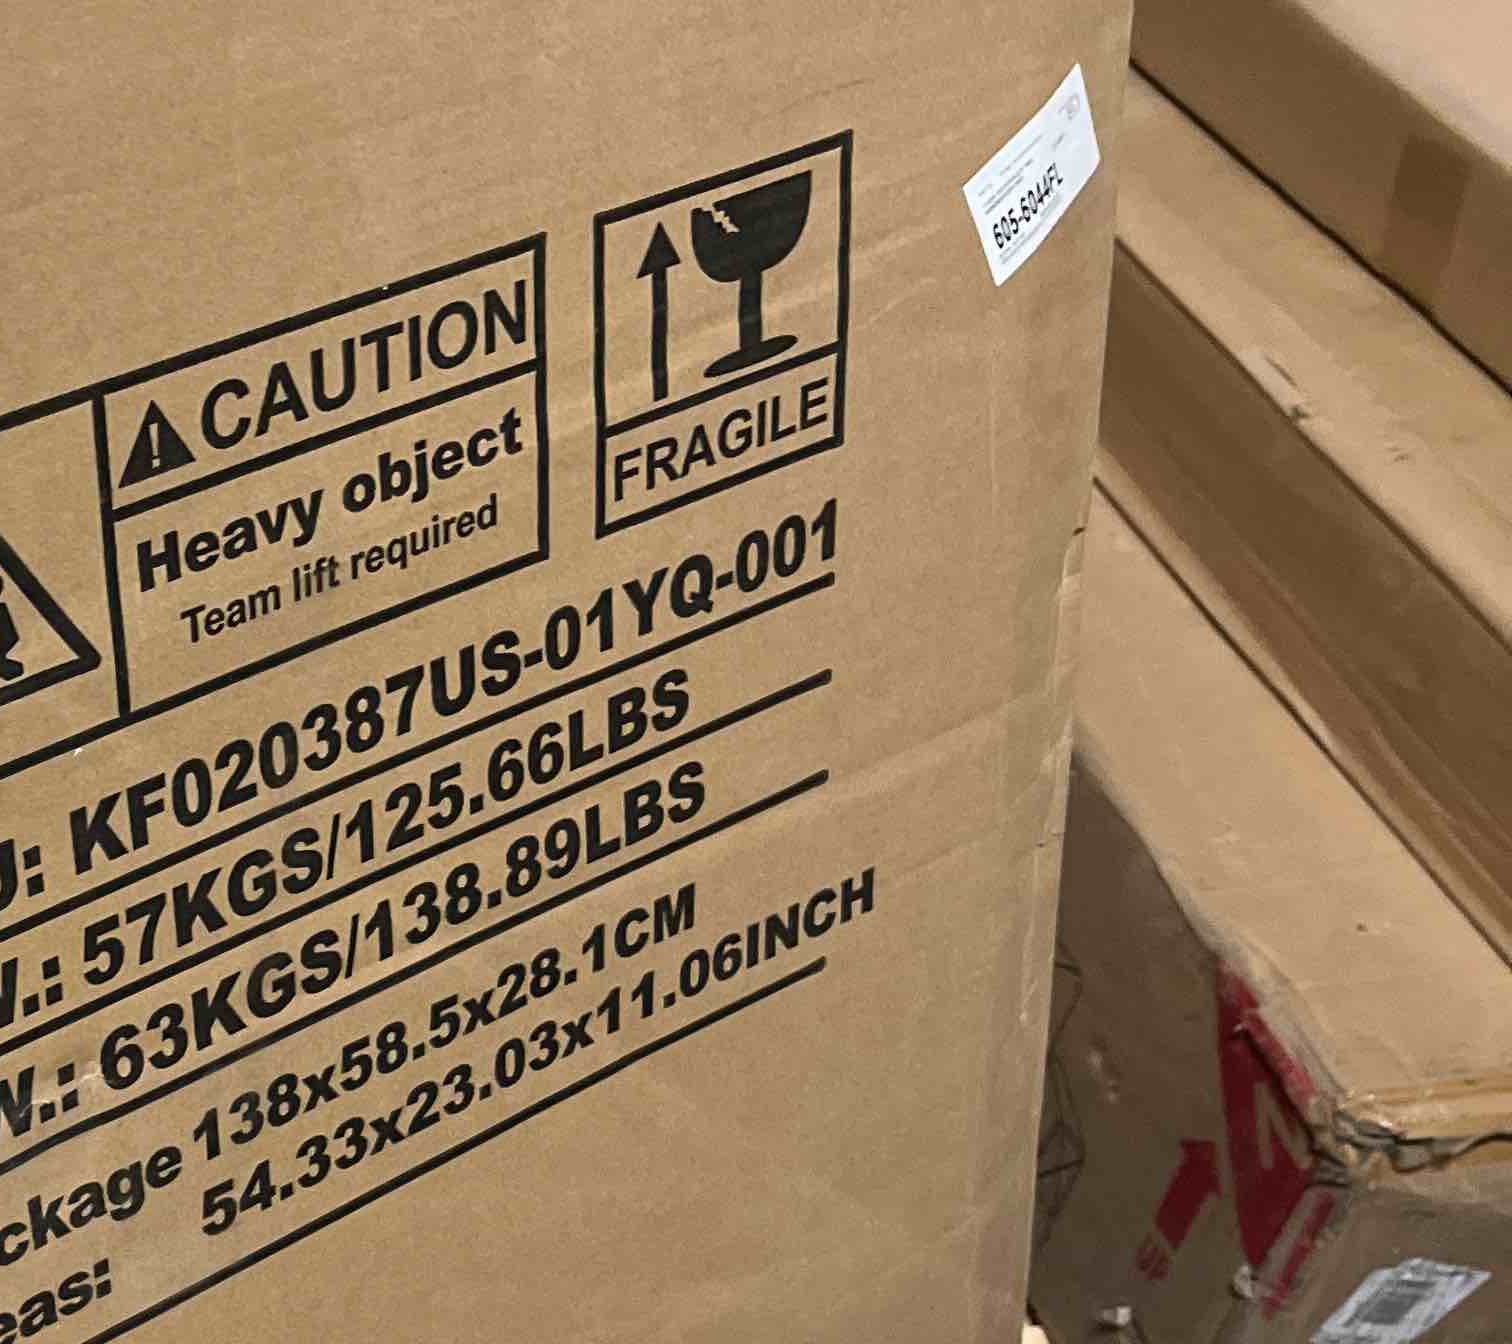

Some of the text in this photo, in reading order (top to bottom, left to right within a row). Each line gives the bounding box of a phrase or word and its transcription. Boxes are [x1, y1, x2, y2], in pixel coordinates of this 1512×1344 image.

[137, 408, 524, 592] Heavy object
[200, 280, 532, 451] CAUTION
[614, 377, 831, 502] FRAGILE
[70, 498, 840, 873] KF020387US-01YQ-001
[181, 493, 498, 645] Team lift required
[83, 670, 691, 985] 57KGS/125.66LBS
[101, 761, 707, 1089] 63KGS/138.89LBS
[193, 883, 697, 1161] 138x58.5x28.1CM
[200, 869, 876, 1235] 54.33x23.03x11.06INCH
